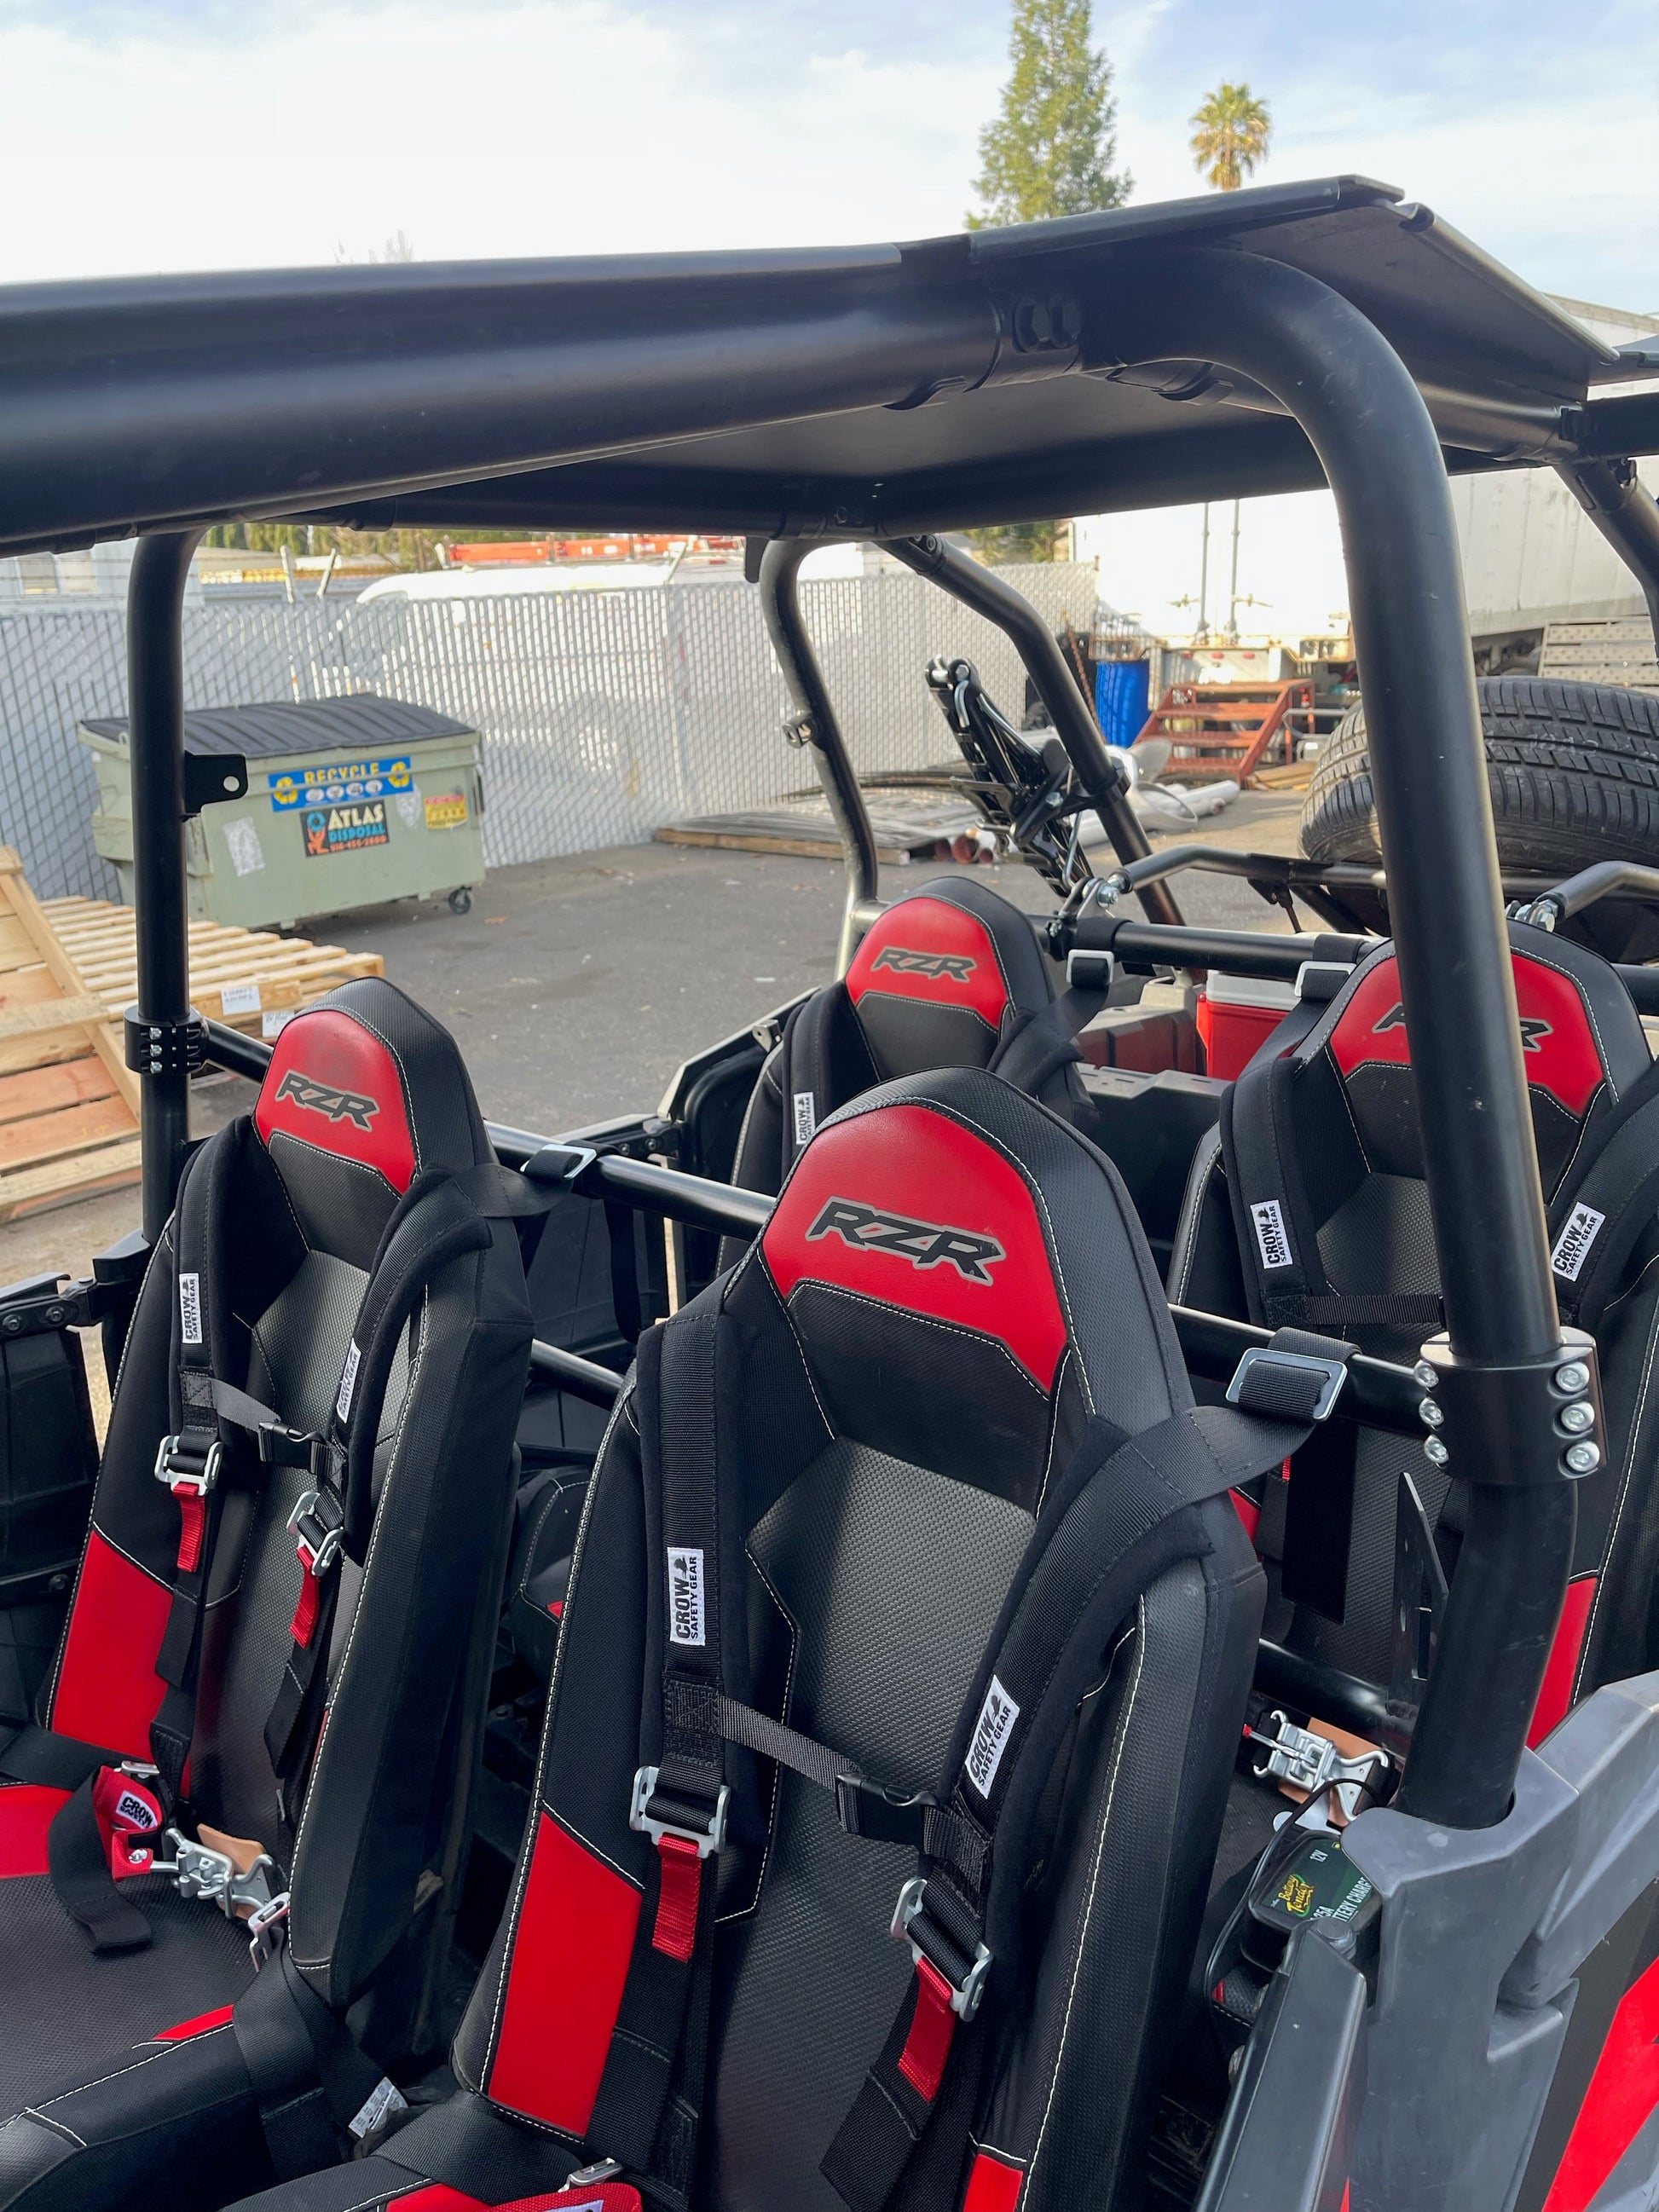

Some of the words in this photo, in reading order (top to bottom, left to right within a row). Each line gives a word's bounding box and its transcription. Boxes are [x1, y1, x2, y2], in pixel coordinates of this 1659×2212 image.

[304, 762, 379, 784] RECYCLE
[327, 803, 384, 830] ATLAS
[328, 822, 386, 844] DISPOSAL
[870, 946, 977, 983] RZR
[275, 1069, 380, 1132] RZR
[798, 1110, 808, 1141] CROW
[1269, 1205, 1279, 1228] GEAR
[805, 1196, 1006, 1286] RZR
[1260, 1223, 1280, 1264] CROW
[1275, 1231, 1286, 1262] SAFETY
[1553, 1224, 1582, 1271] CROW
[1565, 1240, 1585, 1274] SAFETY
[1581, 1216, 1598, 1240] GEAR
[182, 1296, 194, 1340] CROW
[689, 1556, 697, 1590] GEAR
[673, 1577, 691, 1638] CROW
[690, 1593, 698, 1639] SAFETY
[969, 1709, 996, 1780] CROW
[979, 1738, 997, 1786] SAFETY
[993, 1706, 1011, 1740] GEAR
[122, 1796, 153, 1827] CROW
[1309, 1849, 1329, 1863] 12V
[1278, 1874, 1298, 1901] Battery
[1286, 1882, 1315, 1913] Tender
[1331, 1899, 1358, 1923] TTERY
